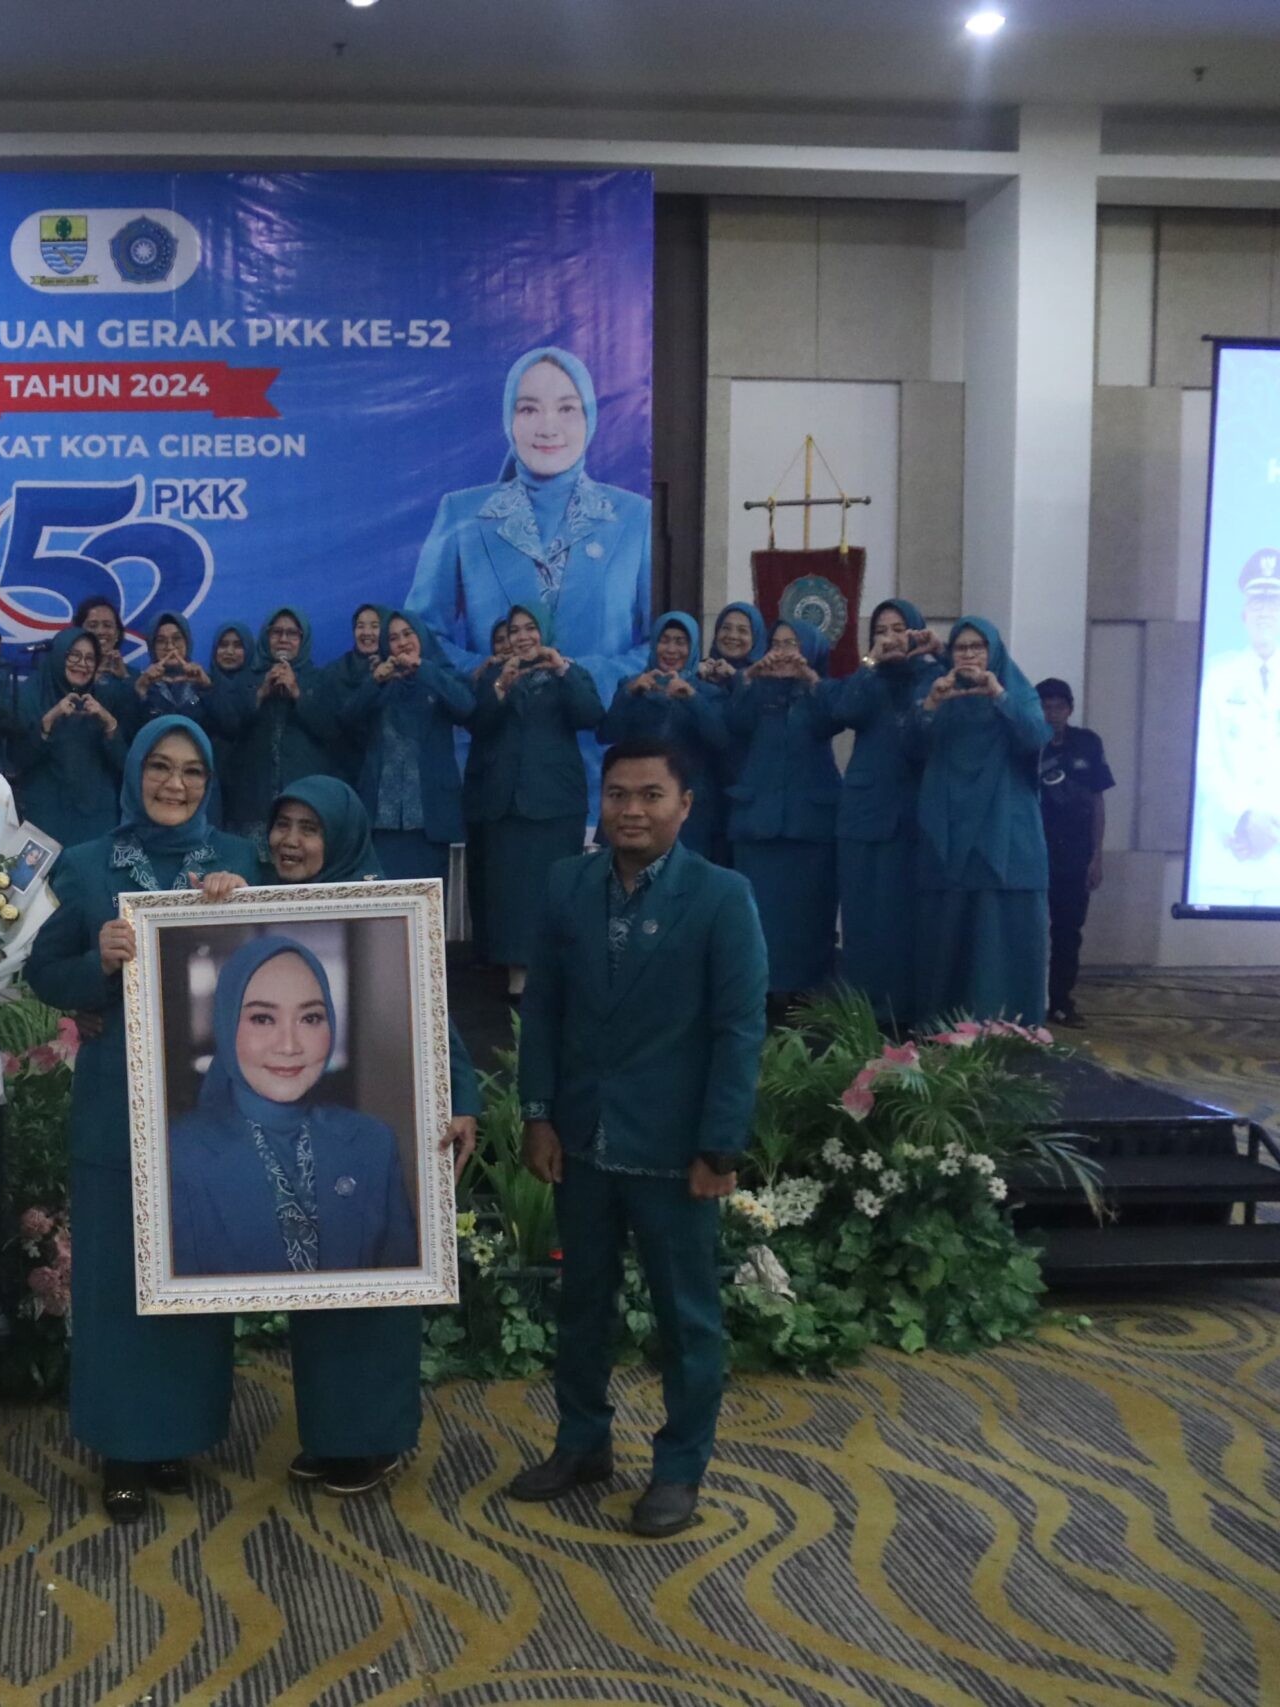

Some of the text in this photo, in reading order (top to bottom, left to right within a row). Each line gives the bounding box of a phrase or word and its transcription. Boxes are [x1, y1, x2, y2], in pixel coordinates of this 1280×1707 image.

[97, 319, 235, 348] GERAK
[246, 319, 329, 347] PKK
[342, 319, 451, 348] KE-52
[4, 373, 210, 398] TAHUN 2024
[60, 434, 150, 459] KOTA
[158, 434, 306, 458] CIREBON
[153, 481, 244, 517] PKK
